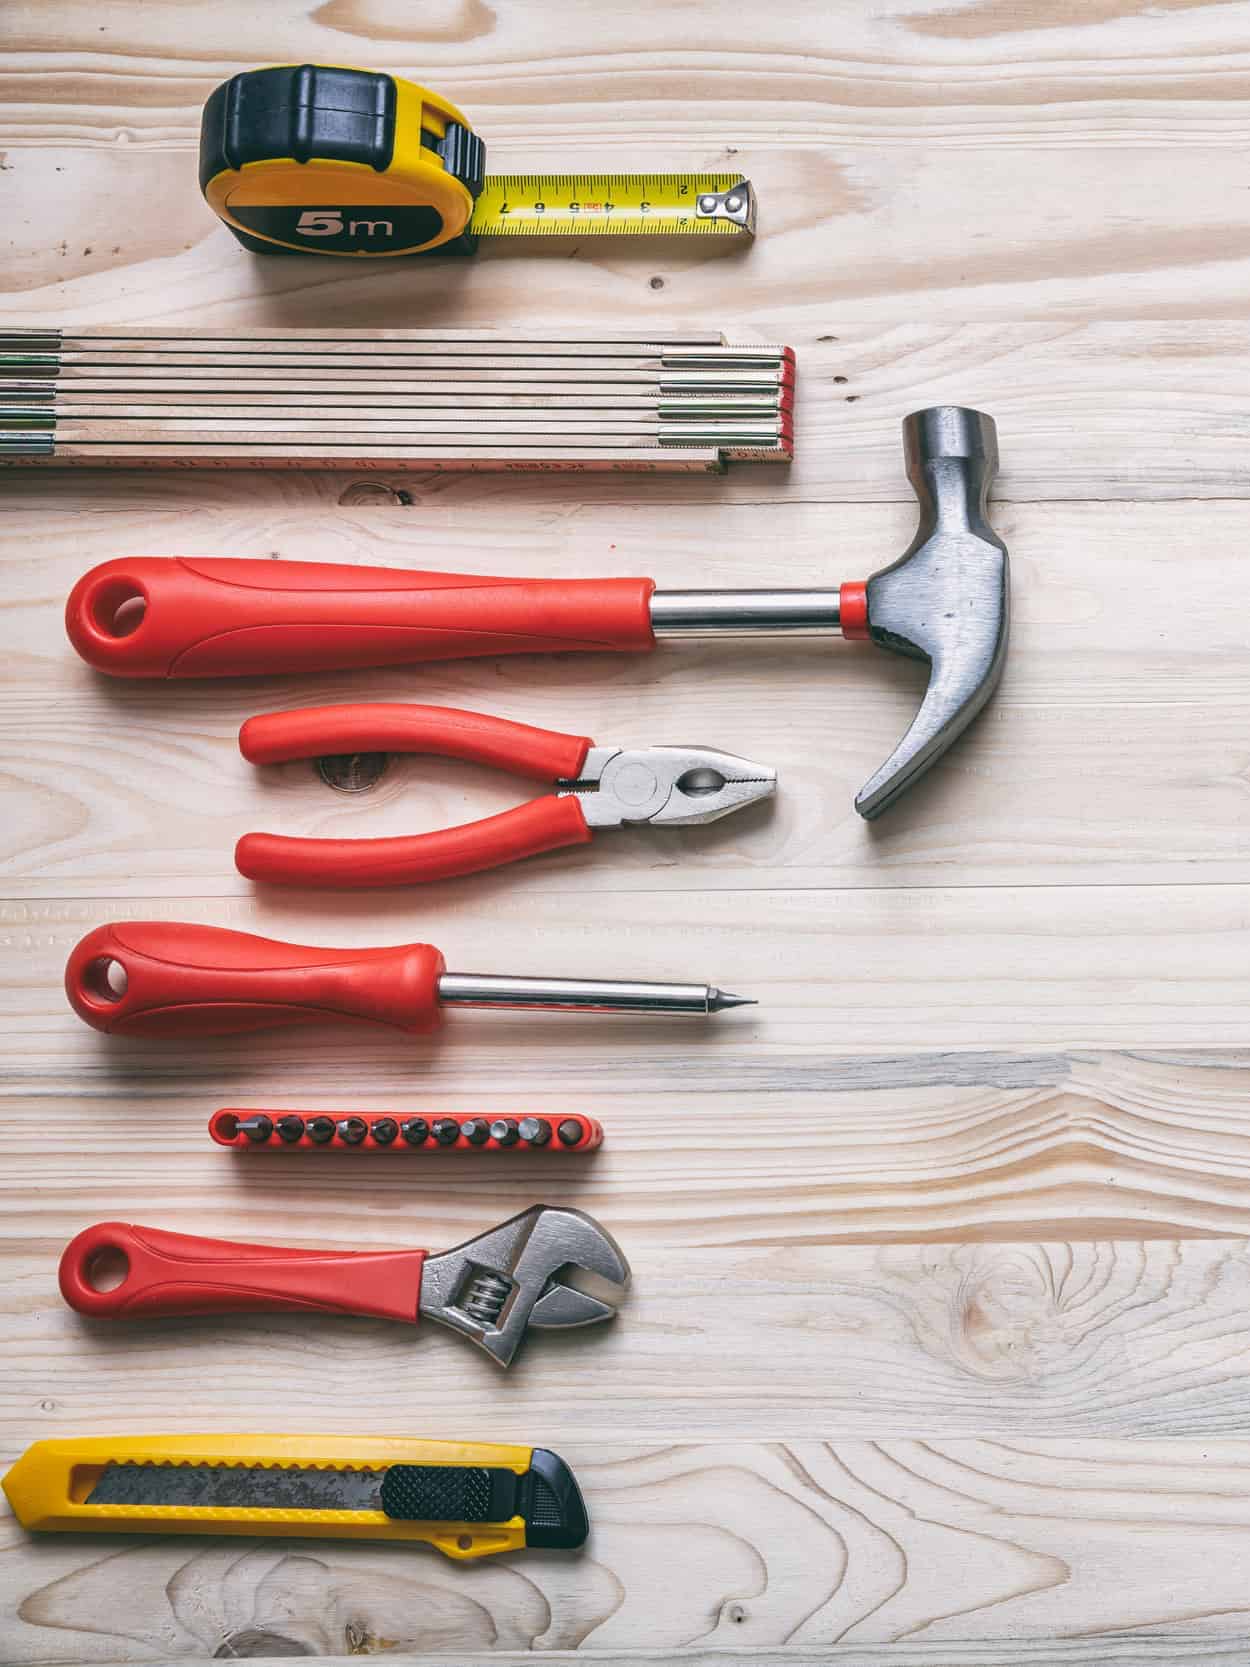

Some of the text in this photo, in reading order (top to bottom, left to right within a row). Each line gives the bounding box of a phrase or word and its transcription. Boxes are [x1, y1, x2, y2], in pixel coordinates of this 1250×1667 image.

[680, 185, 688, 195] 2
[499, 203, 510, 214] 7
[534, 202, 545, 213] 6
[569, 202, 580, 213] 5
[604, 202, 615, 213] 4
[640, 202, 651, 213] 3
